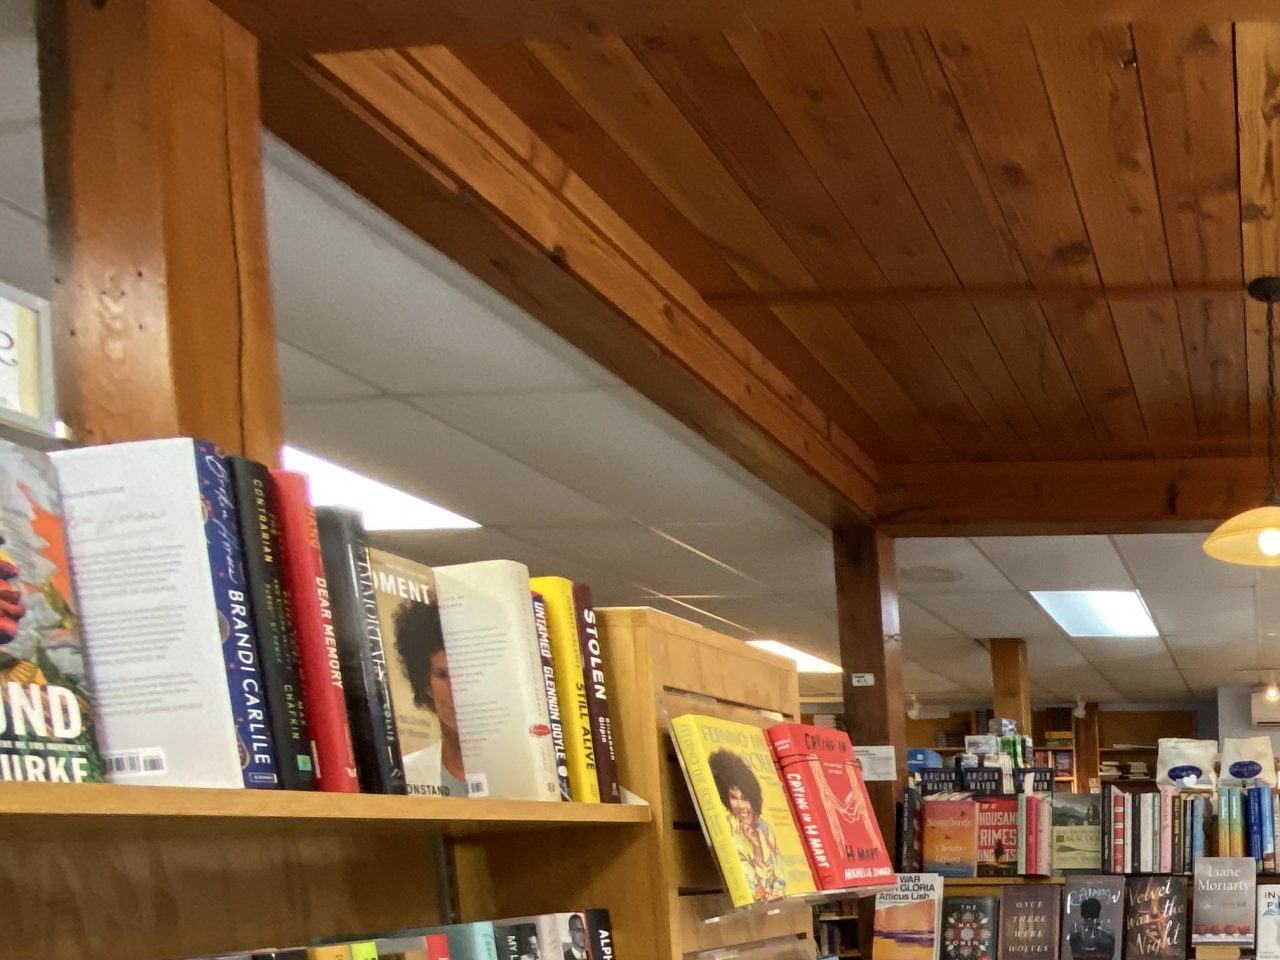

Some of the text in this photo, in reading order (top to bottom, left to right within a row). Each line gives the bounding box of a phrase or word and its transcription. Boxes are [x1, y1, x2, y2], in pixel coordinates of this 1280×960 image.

[253, 479, 273, 563] CONTRARIAN
[316, 577, 343, 689] DEAR MEMORY
[583, 609, 607, 699] STOLEN
[228, 590, 270, 765] BRANDI CARLILE
[533, 601, 567, 760] UNTAMED GLENNON DOYLE
[576, 683, 595, 770] STILL ALIVE
[804, 733, 835, 752] CRYING
[924, 772, 955, 781] ARCHER
[967, 772, 999, 780] ARCHER
[927, 783, 953, 791] MAYOR
[970, 782, 996, 790] MAYOR
[787, 773, 830, 868] CRYING MART
[1207, 865, 1241, 877] Liane
[901, 884, 935, 892] GLORIA
[1197, 879, 1250, 892] Moriarty
[879, 892, 930, 901] Atticus Lish
[1264, 891, 1277, 899] IN
[1016, 901, 1044, 909] ONCE
[1012, 915, 1047, 923] THERE
[1014, 930, 1043, 938] WERE
[1136, 919, 1180, 956] Night
[1008, 944, 1049, 953] WOLVES
